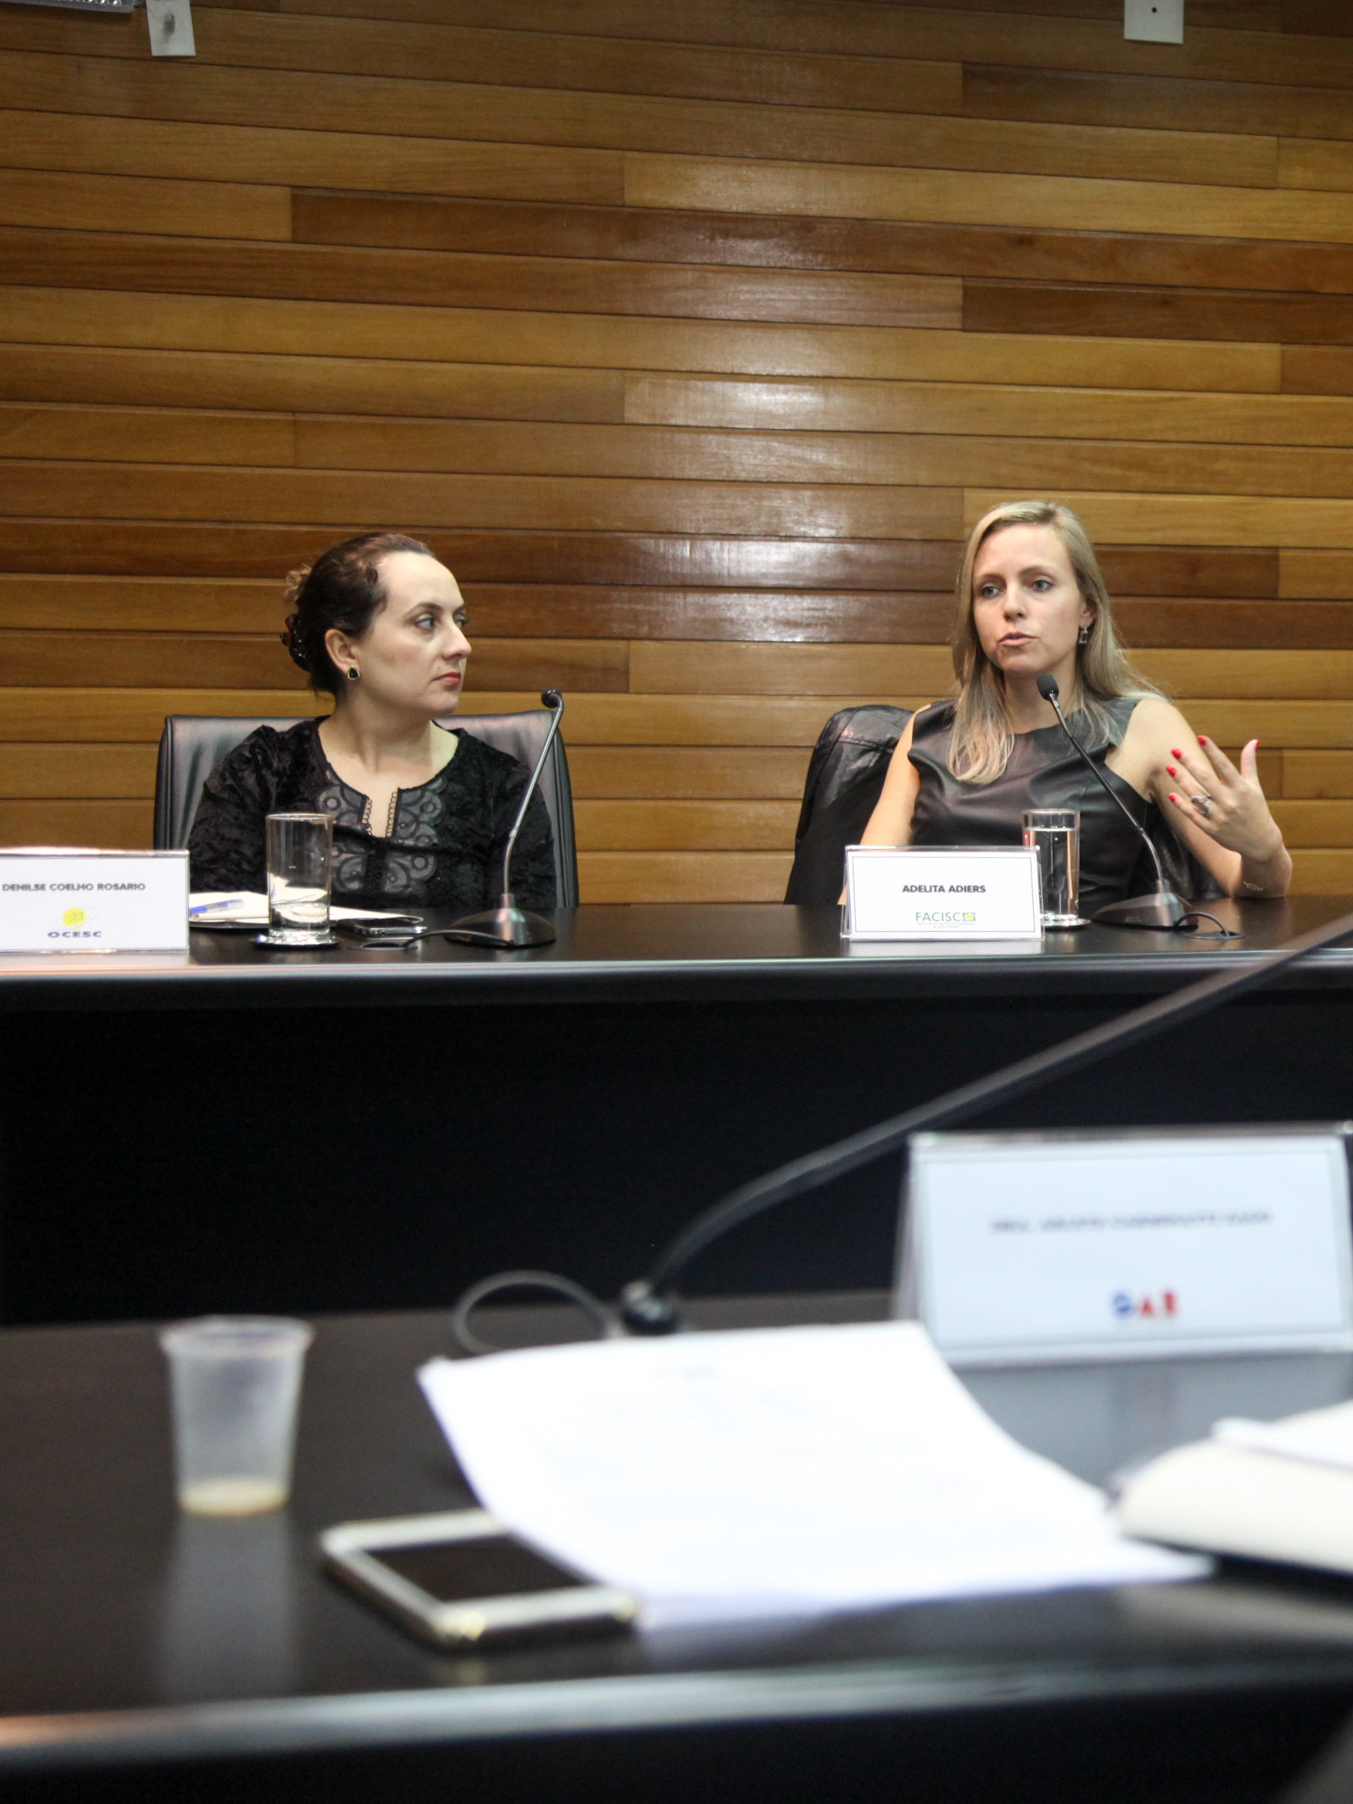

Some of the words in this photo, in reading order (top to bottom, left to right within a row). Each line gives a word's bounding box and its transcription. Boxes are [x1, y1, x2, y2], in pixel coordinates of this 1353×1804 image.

[2, 883, 46, 891] DENILSE
[50, 883, 94, 891] COELHO
[902, 885, 945, 893] ADELITA
[948, 885, 986, 893] ADIERS
[915, 911, 962, 922] FACISC
